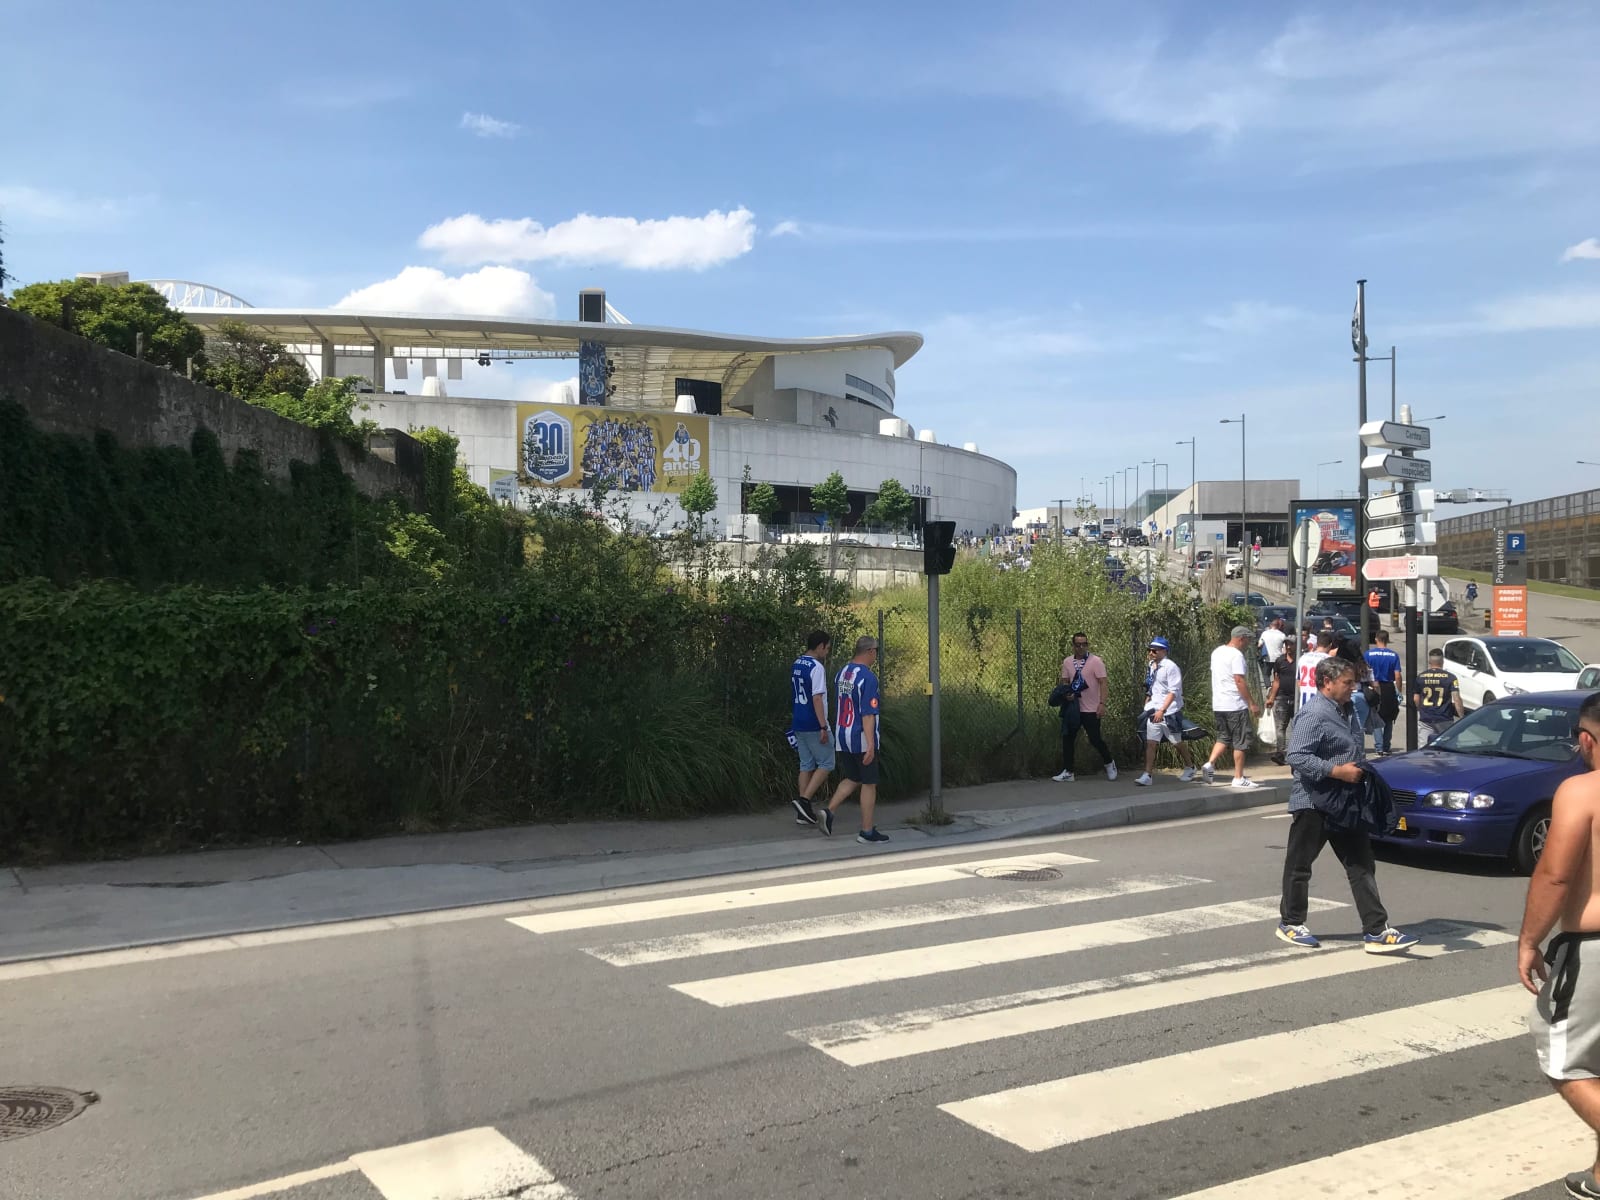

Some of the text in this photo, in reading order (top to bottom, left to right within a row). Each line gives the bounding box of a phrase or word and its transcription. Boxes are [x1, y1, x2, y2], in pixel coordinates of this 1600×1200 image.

[533, 422, 563, 456] 30
[663, 438, 701, 462] 40
[663, 461, 701, 471] anos
[911, 484, 931, 496] 12-18
[1512, 539, 1520, 548] P
[1496, 530, 1505, 584] ParqueMetro
[792, 677, 808, 705] 15
[1422, 687, 1445, 707] 27
[838, 695, 855, 728] 18
